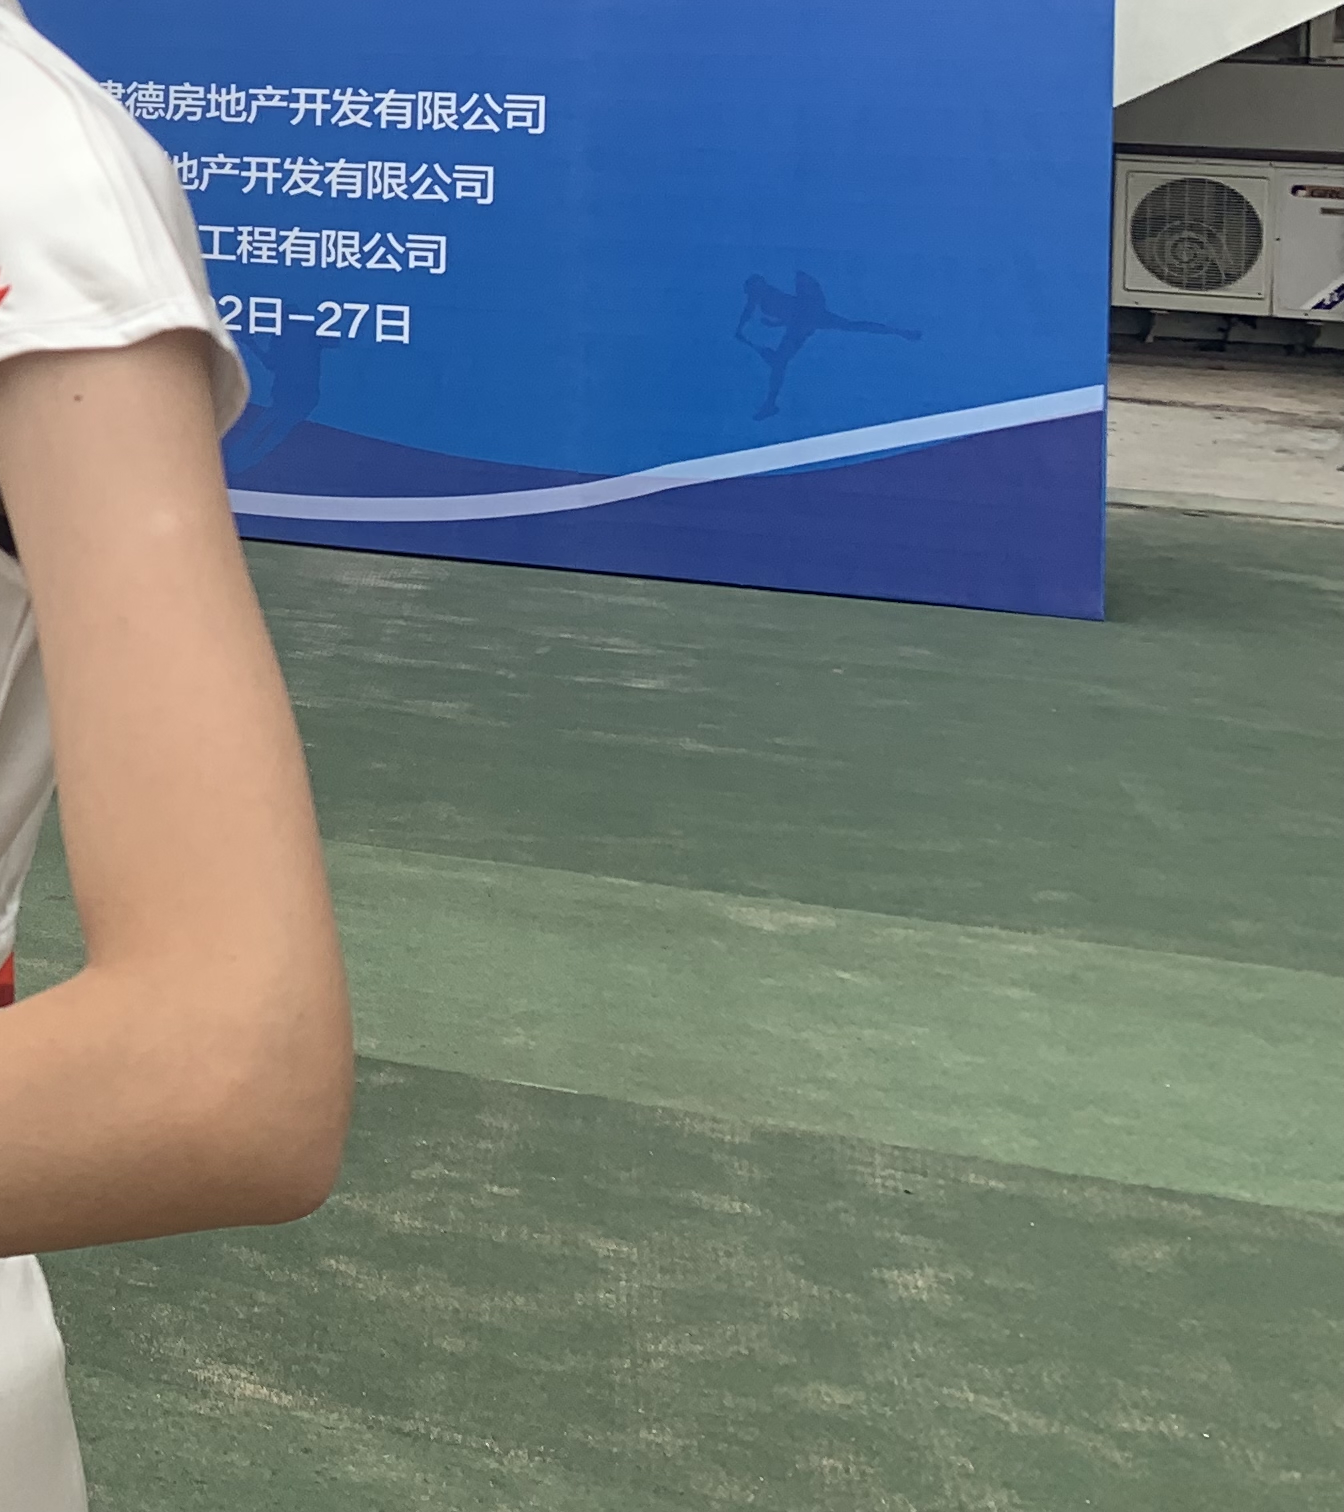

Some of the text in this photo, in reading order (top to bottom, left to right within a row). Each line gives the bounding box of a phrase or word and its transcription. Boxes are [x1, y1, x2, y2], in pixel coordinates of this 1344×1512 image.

[198, 223, 448, 275] 工程有限公司
[209, 294, 412, 345] 2日-27日
